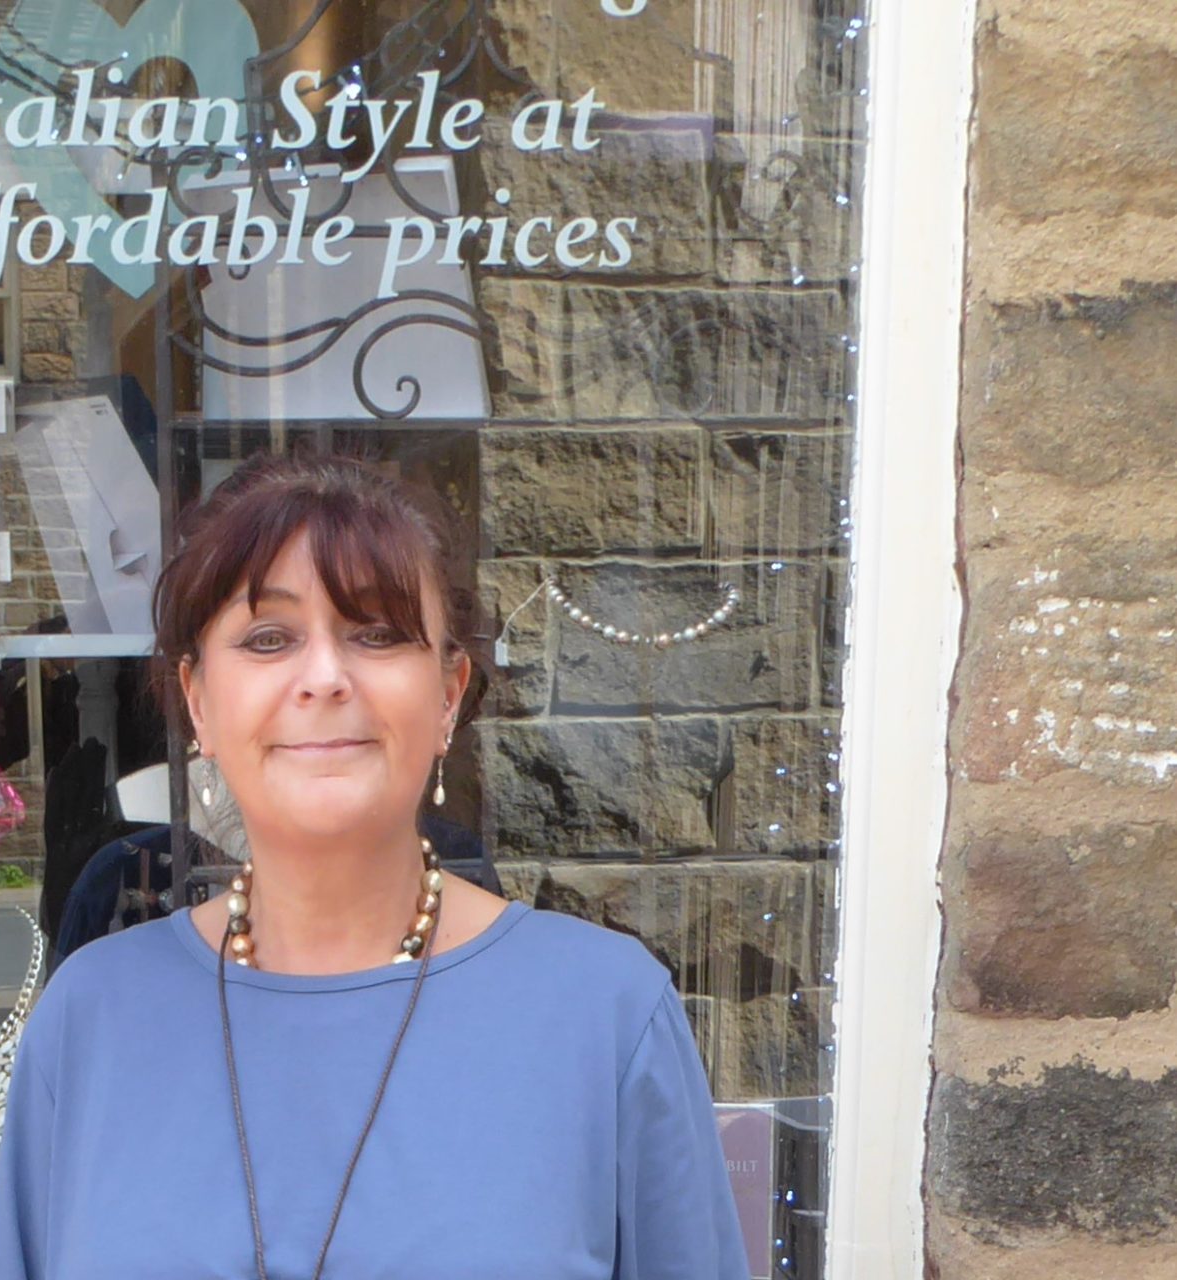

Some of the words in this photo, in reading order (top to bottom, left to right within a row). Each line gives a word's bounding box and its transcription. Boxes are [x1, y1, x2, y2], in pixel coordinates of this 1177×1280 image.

[271, 69, 485, 183] Style
[511, 87, 606, 151] at
[377, 188, 638, 300] prices
